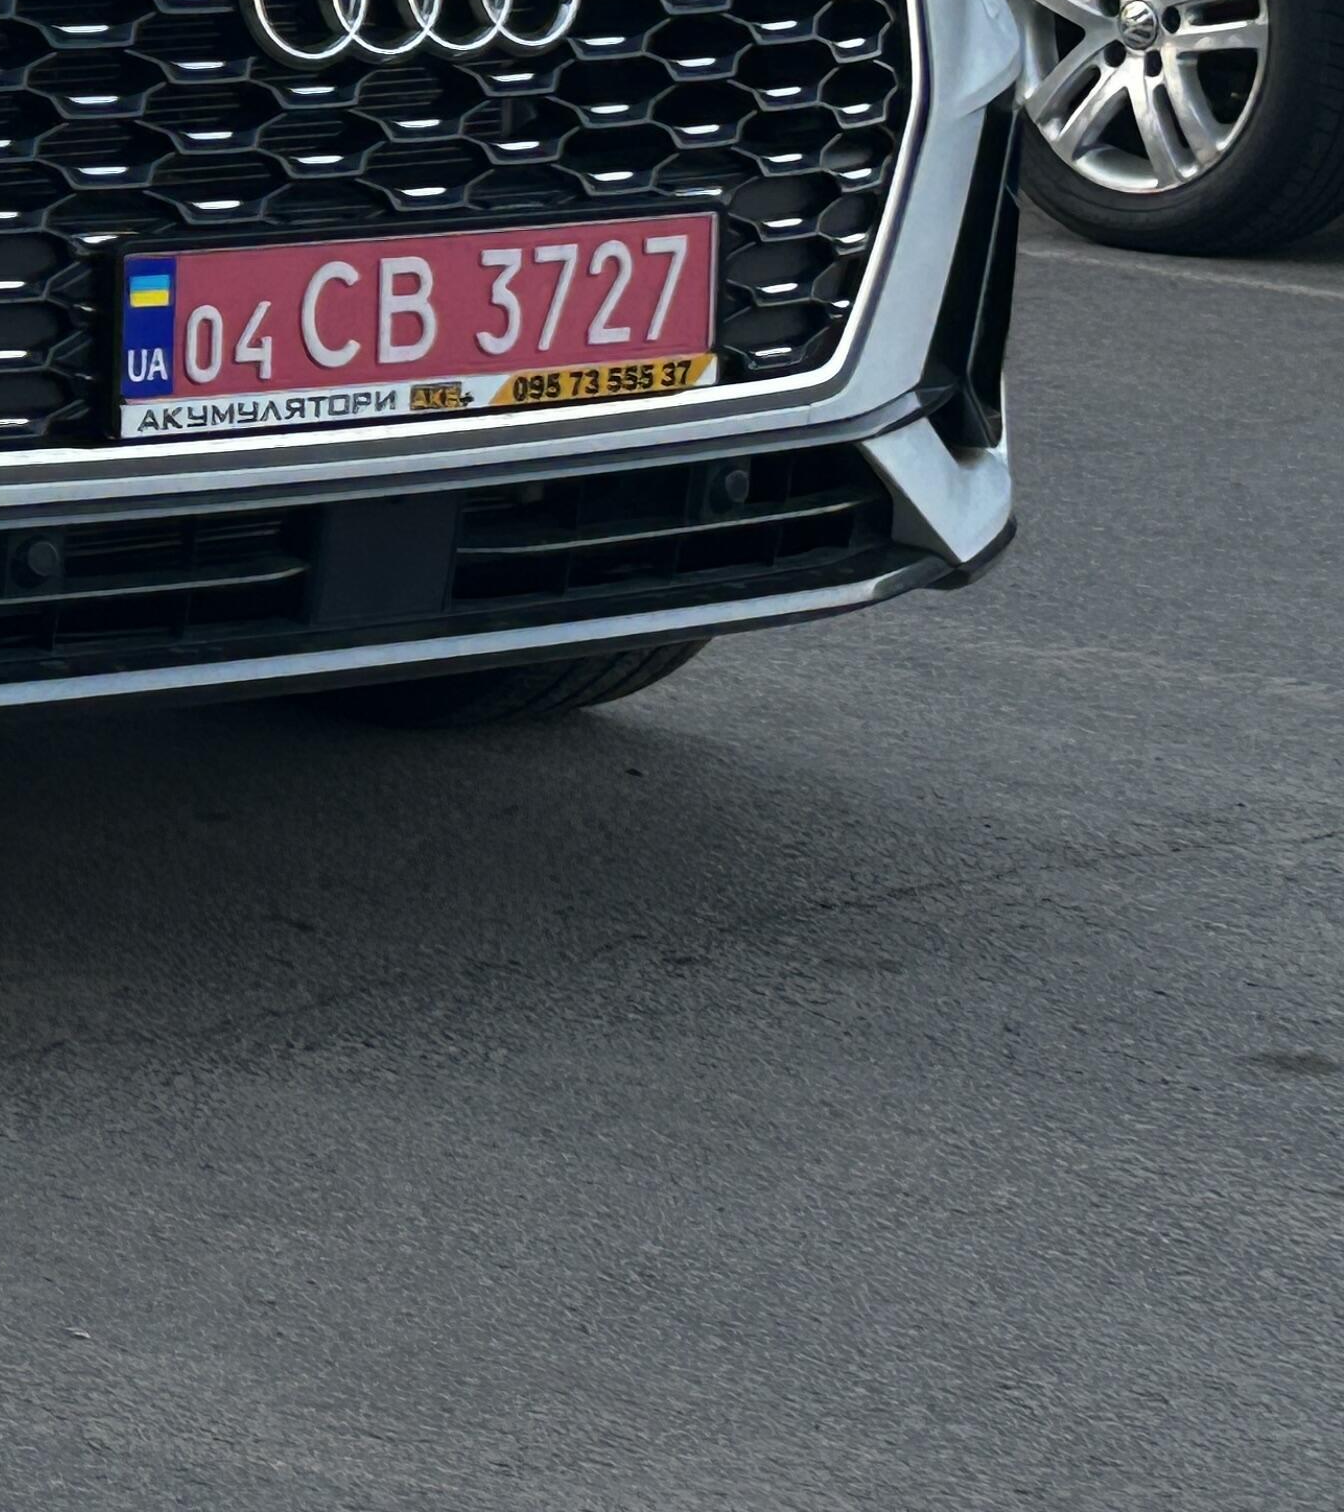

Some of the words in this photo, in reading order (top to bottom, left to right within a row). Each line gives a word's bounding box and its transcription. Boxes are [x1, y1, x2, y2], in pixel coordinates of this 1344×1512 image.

[185, 300, 273, 383] 04
[301, 256, 437, 368] CB
[476, 234, 688, 355] 3727
[127, 348, 168, 382] UA
[137, 390, 396, 432] АКУМУЛЯТОРИ
[513, 373, 561, 401] 095
[570, 369, 600, 396] 73
[607, 365, 654, 392] 555
[661, 360, 692, 386] 37
